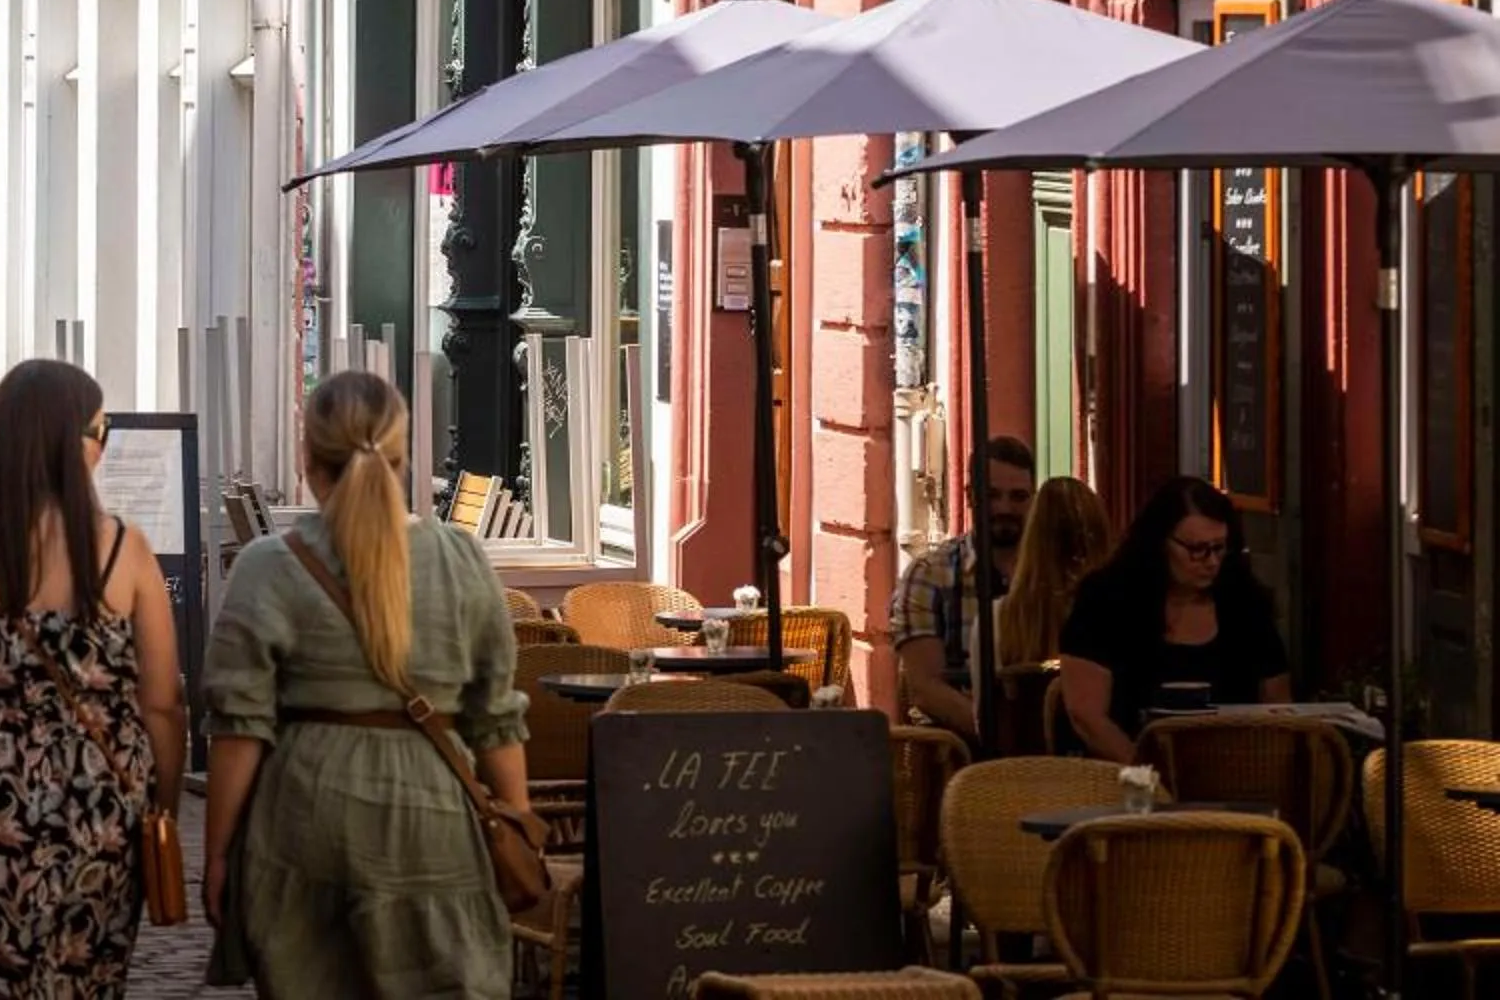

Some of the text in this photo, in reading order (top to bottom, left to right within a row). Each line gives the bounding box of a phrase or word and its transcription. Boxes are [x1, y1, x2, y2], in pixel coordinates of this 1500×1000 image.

[754, 811, 799, 848] you
[646, 873, 743, 905] Excellent
[675, 916, 812, 950] Soul Food
